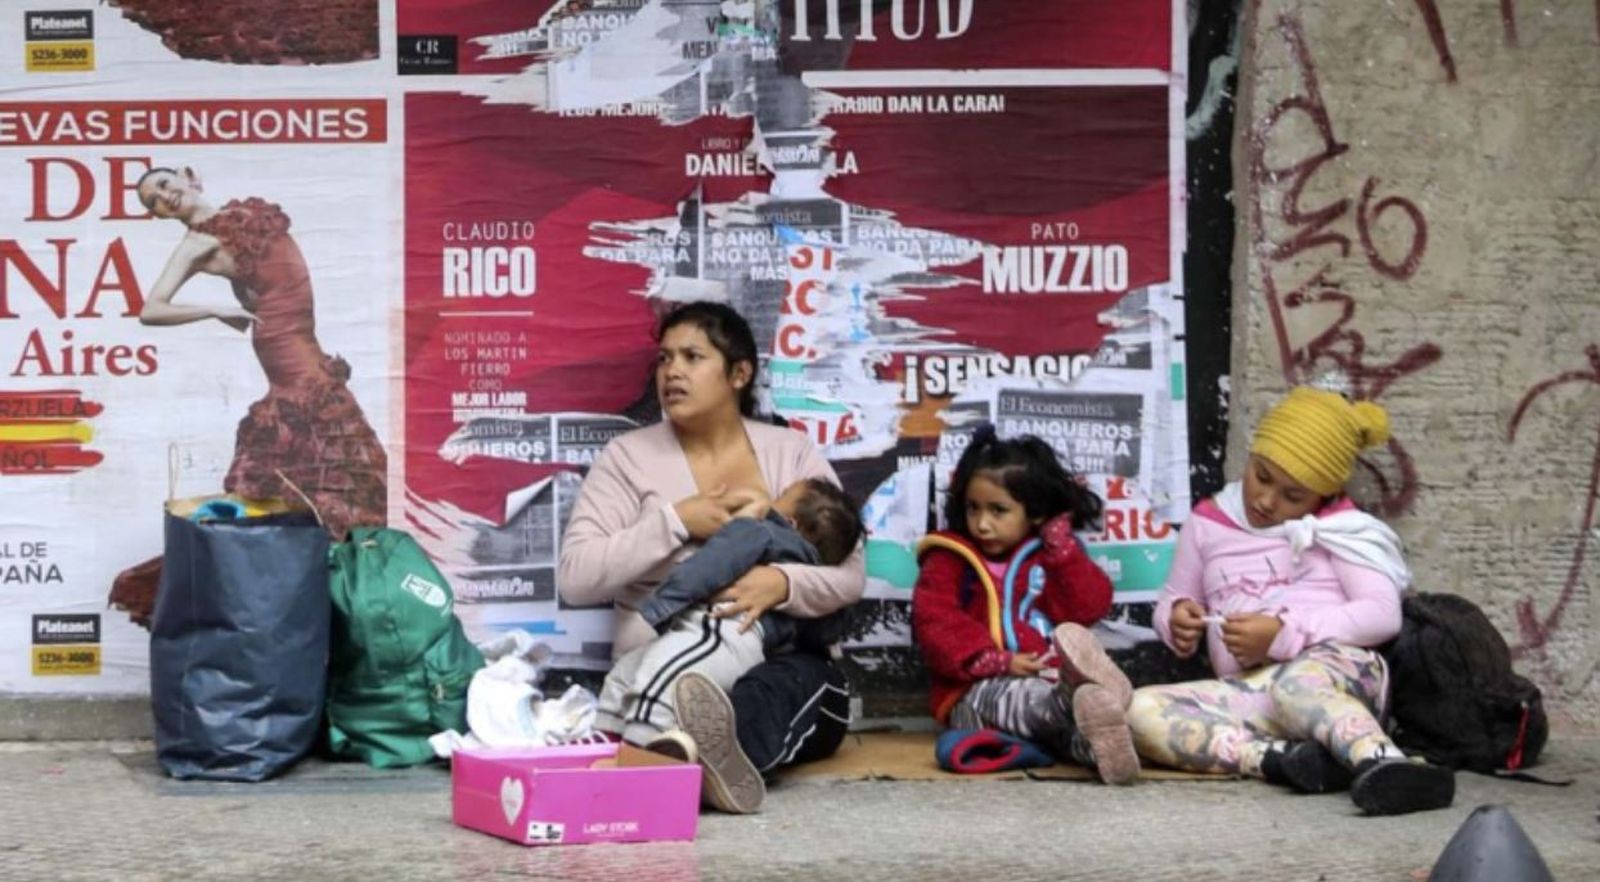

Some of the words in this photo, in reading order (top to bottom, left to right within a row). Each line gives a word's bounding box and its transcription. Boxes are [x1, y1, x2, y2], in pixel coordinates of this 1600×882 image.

[888, 95, 923, 113] DAN
[927, 94, 949, 113] LA
[0, 112, 109, 141] EVAS
[124, 108, 369, 140] FUNCIONES
[24, 157, 152, 220] DE
[442, 222, 535, 241] CLAUDIO
[1031, 222, 1079, 240] PATO
[0, 237, 147, 320] NA
[442, 246, 537, 297] RICO
[982, 245, 1129, 293] MUZZIO
[10, 328, 158, 377] Aires
[444, 347, 468, 361] LOS
[1003, 419, 1133, 440] BANQUEROS
[1074, 439, 1131, 457] PARA
[20, 541, 47, 558] DE
